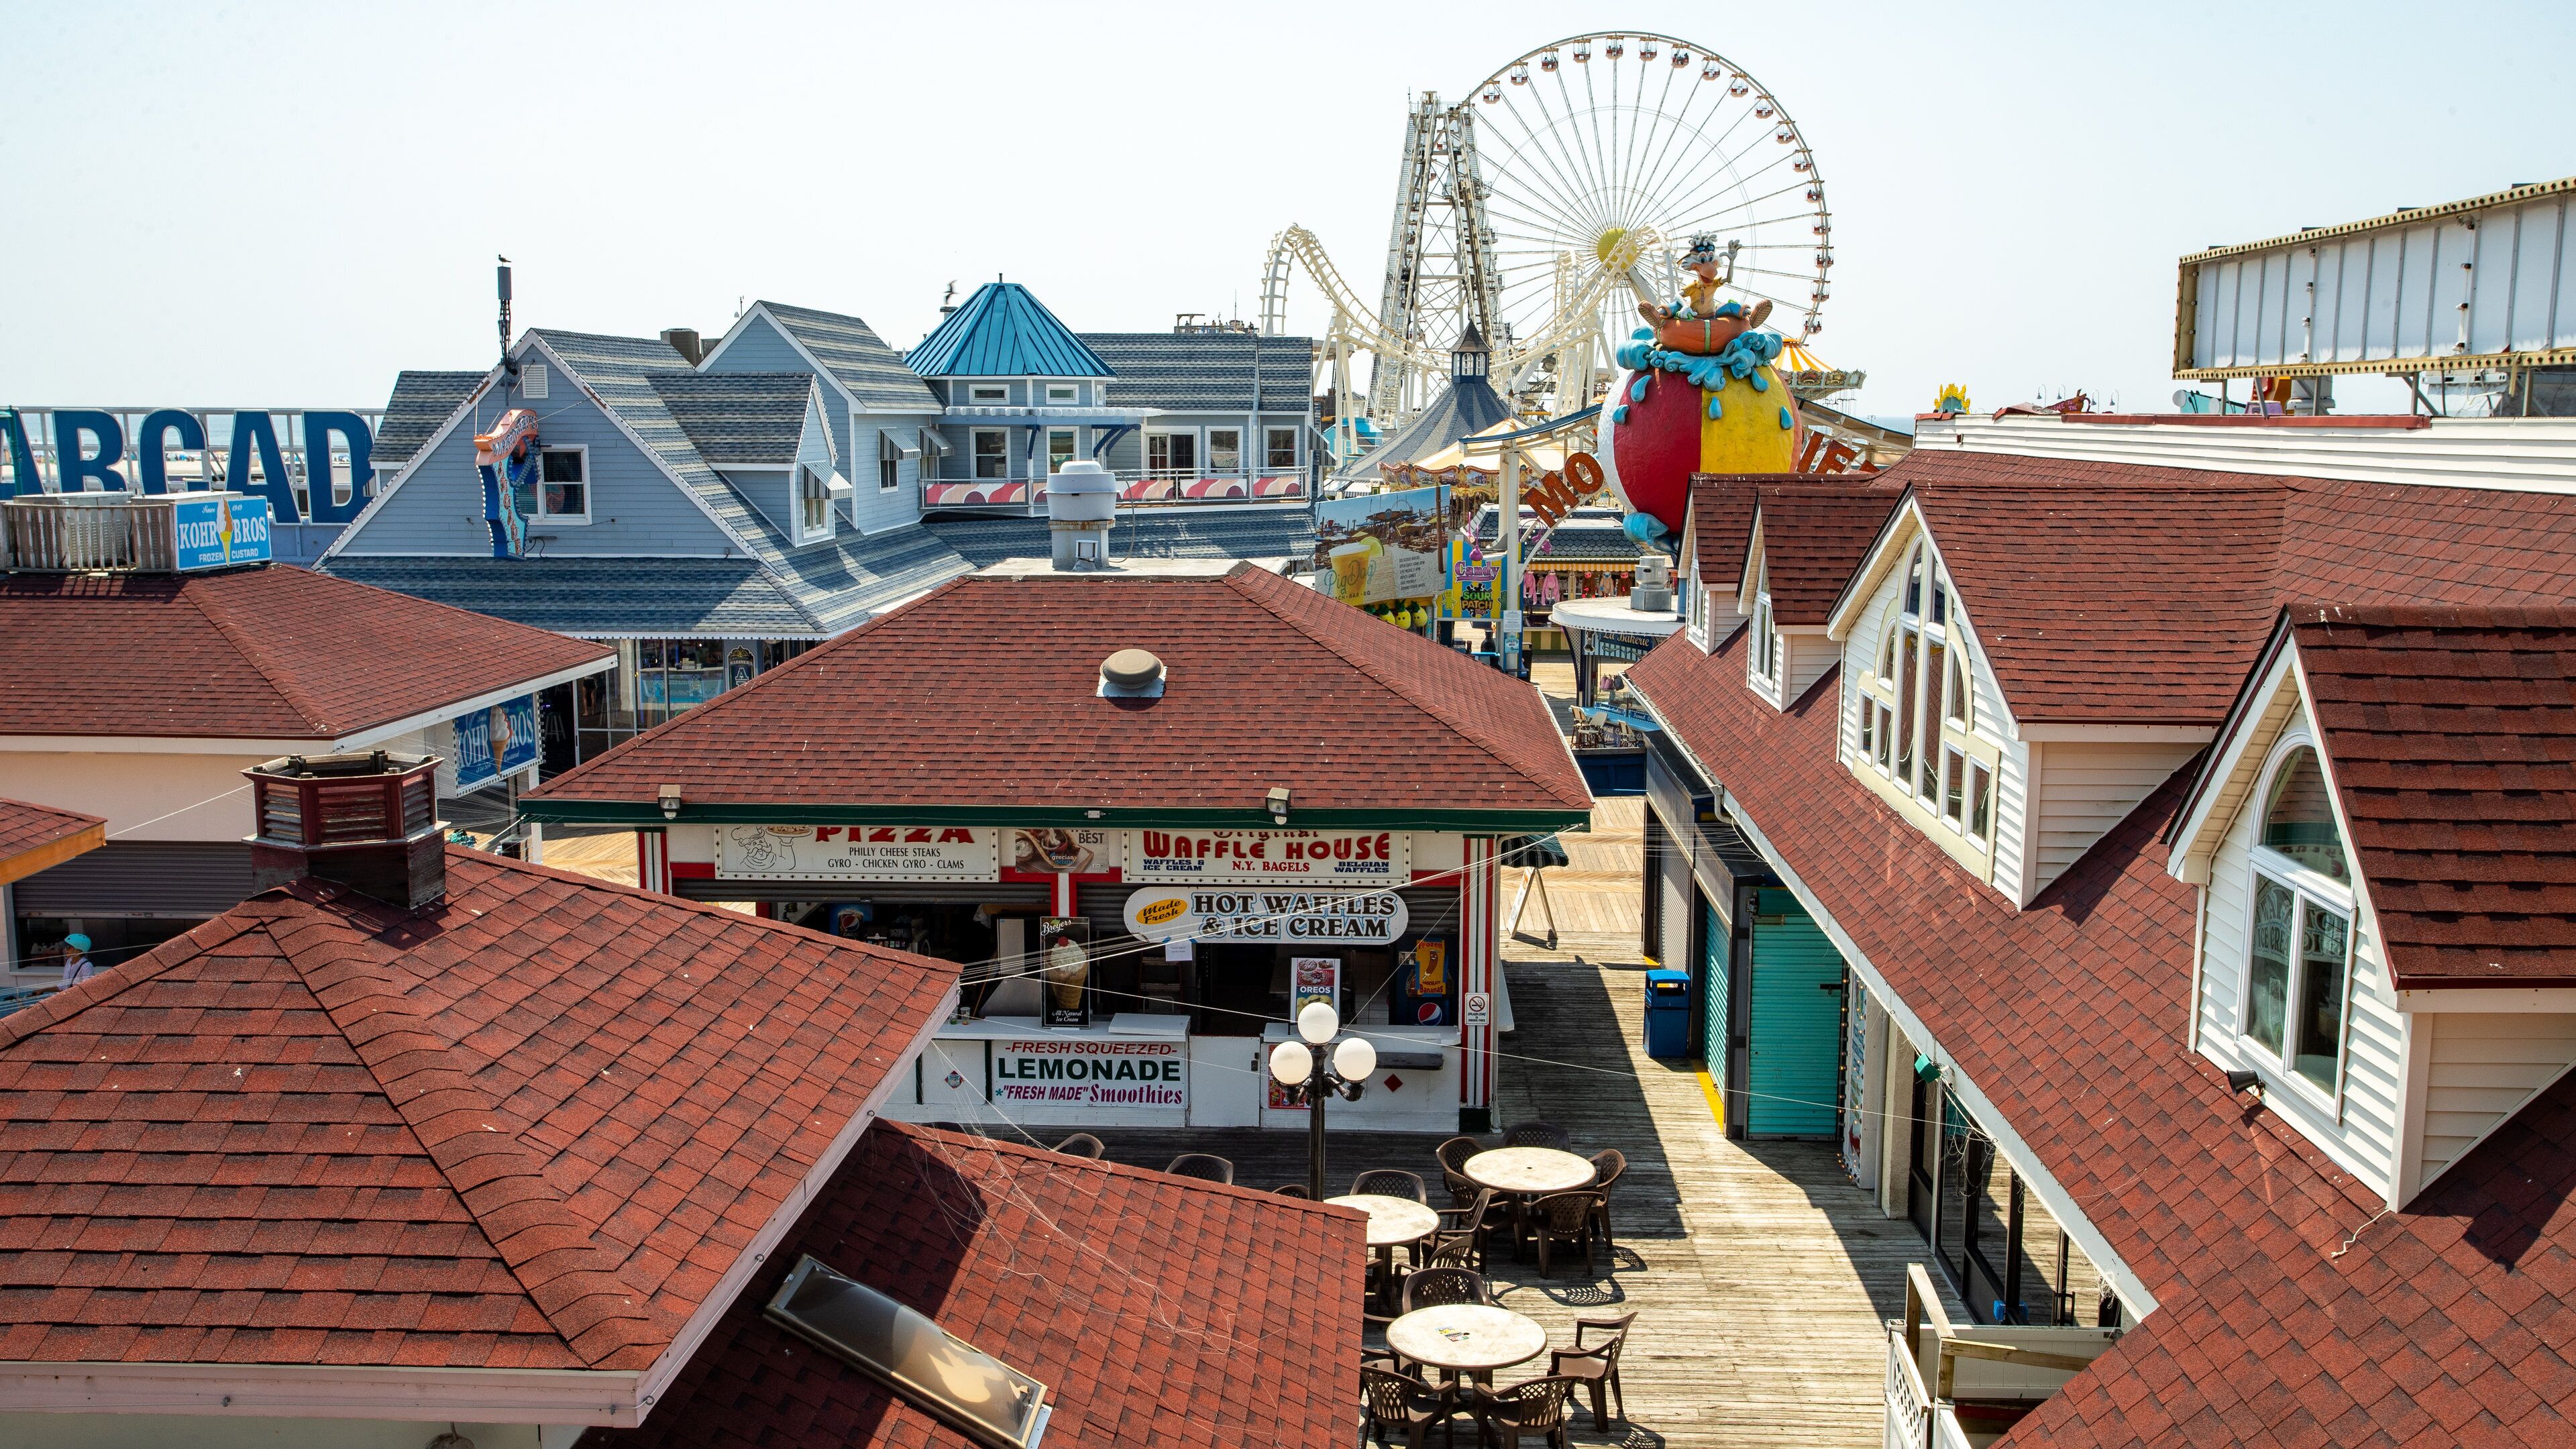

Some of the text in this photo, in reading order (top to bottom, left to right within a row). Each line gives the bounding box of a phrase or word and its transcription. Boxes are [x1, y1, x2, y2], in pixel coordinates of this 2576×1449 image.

[202, 505, 215, 514] Since
[179, 517, 267, 549] KOHR BROS
[199, 548, 258, 563] FROZEN CUSTARD
[1454, 561, 1501, 578] Candy
[1463, 592, 1491, 600] SOUR
[1461, 600, 1493, 609] PATCH
[456, 709, 533, 769] KOHR ROS
[816, 827, 975, 843] PIZZA
[1079, 833, 1104, 844] BEST
[849, 847, 941, 857] PHILLY CHEESE STEAKS
[1143, 830, 1389, 860] WAFFLE HOUSE
[828, 859, 851, 868] GYRO
[863, 859, 898, 868] CHICKEN
[903, 859, 926, 869] GYRO
[937, 860, 964, 869] CLAMS
[1232, 861, 1310, 872] N.Y. BAGELS
[1143, 900, 1181, 916] Made
[1194, 895, 1395, 915] HOT WAFFLES
[1144, 908, 1179, 924] Fresh
[1041, 920, 1071, 935] Breyers
[1203, 917, 1387, 937] & ICE CREAM
[1418, 941, 1442, 949] Frozen
[1419, 985, 1444, 994] Bananas
[1005, 1042, 1177, 1055] -FRESH SQUEEZED-
[998, 1058, 1181, 1081] LEMONADE
[1089, 1083, 1183, 1104] Smoothies
